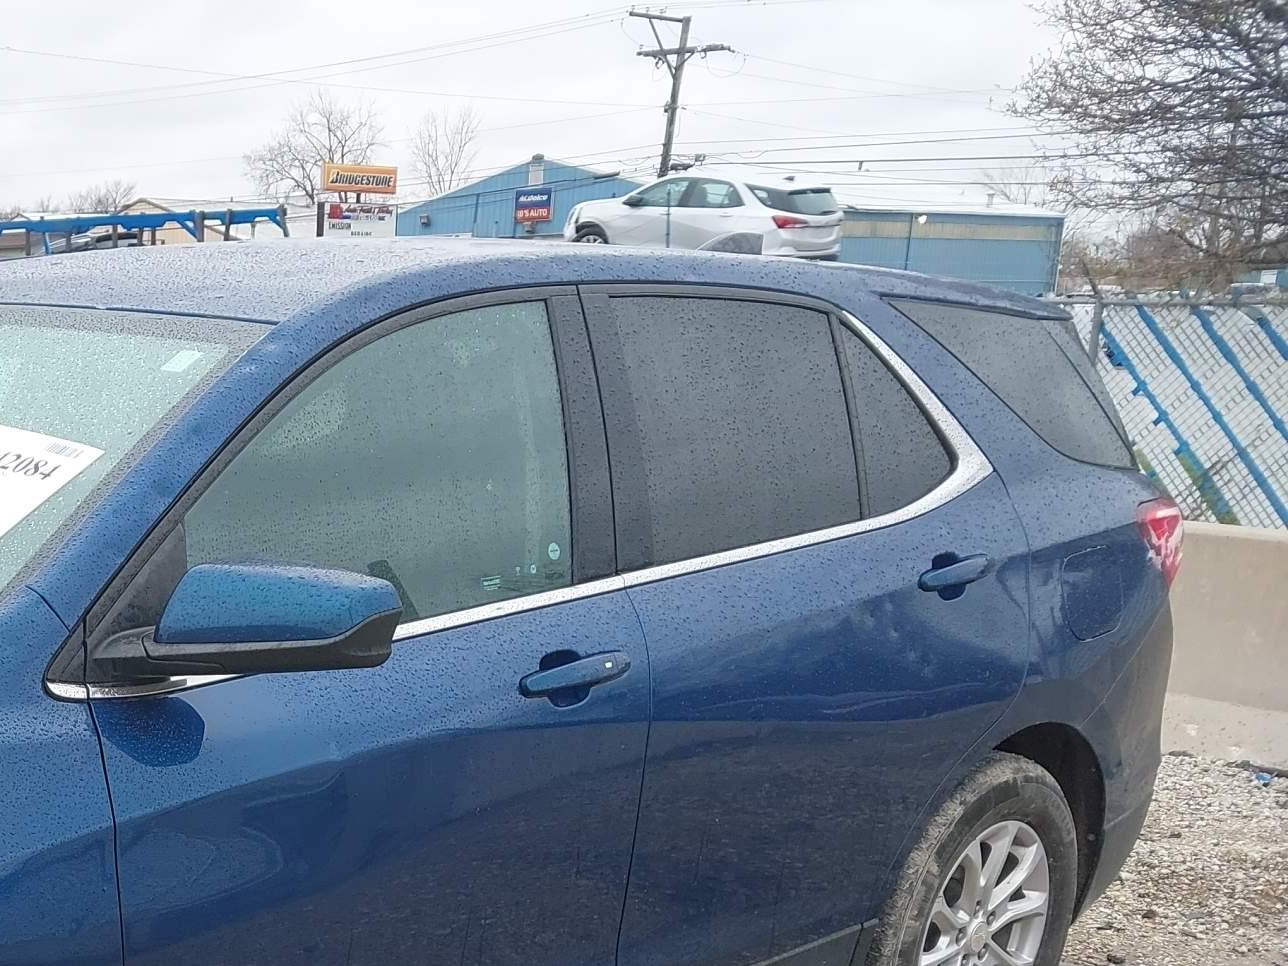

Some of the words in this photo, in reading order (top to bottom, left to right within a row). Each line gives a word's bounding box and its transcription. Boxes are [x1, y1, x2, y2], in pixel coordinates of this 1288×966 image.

[330, 171, 393, 187] BRIDGESTONE
[530, 208, 548, 217] AUTO
[329, 222, 351, 230] EMISSION
